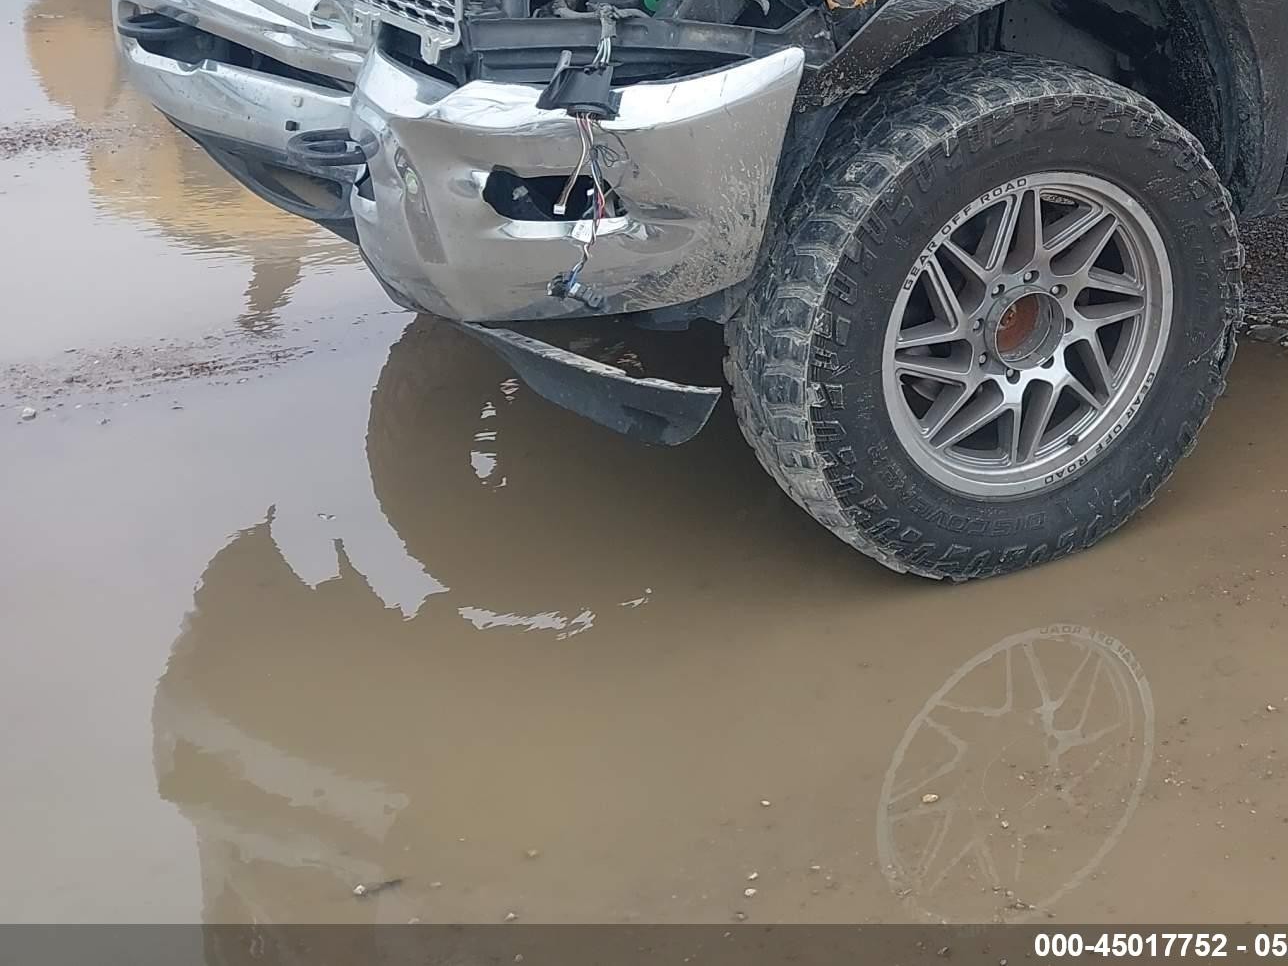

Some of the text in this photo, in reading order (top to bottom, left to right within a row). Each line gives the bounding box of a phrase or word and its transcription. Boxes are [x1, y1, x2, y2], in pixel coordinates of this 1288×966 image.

[903, 241, 938, 291] GEAR
[941, 205, 972, 236] OFF
[981, 178, 1027, 204] ROAD
[1044, 372, 1155, 485] GEAR OFF ROAD
